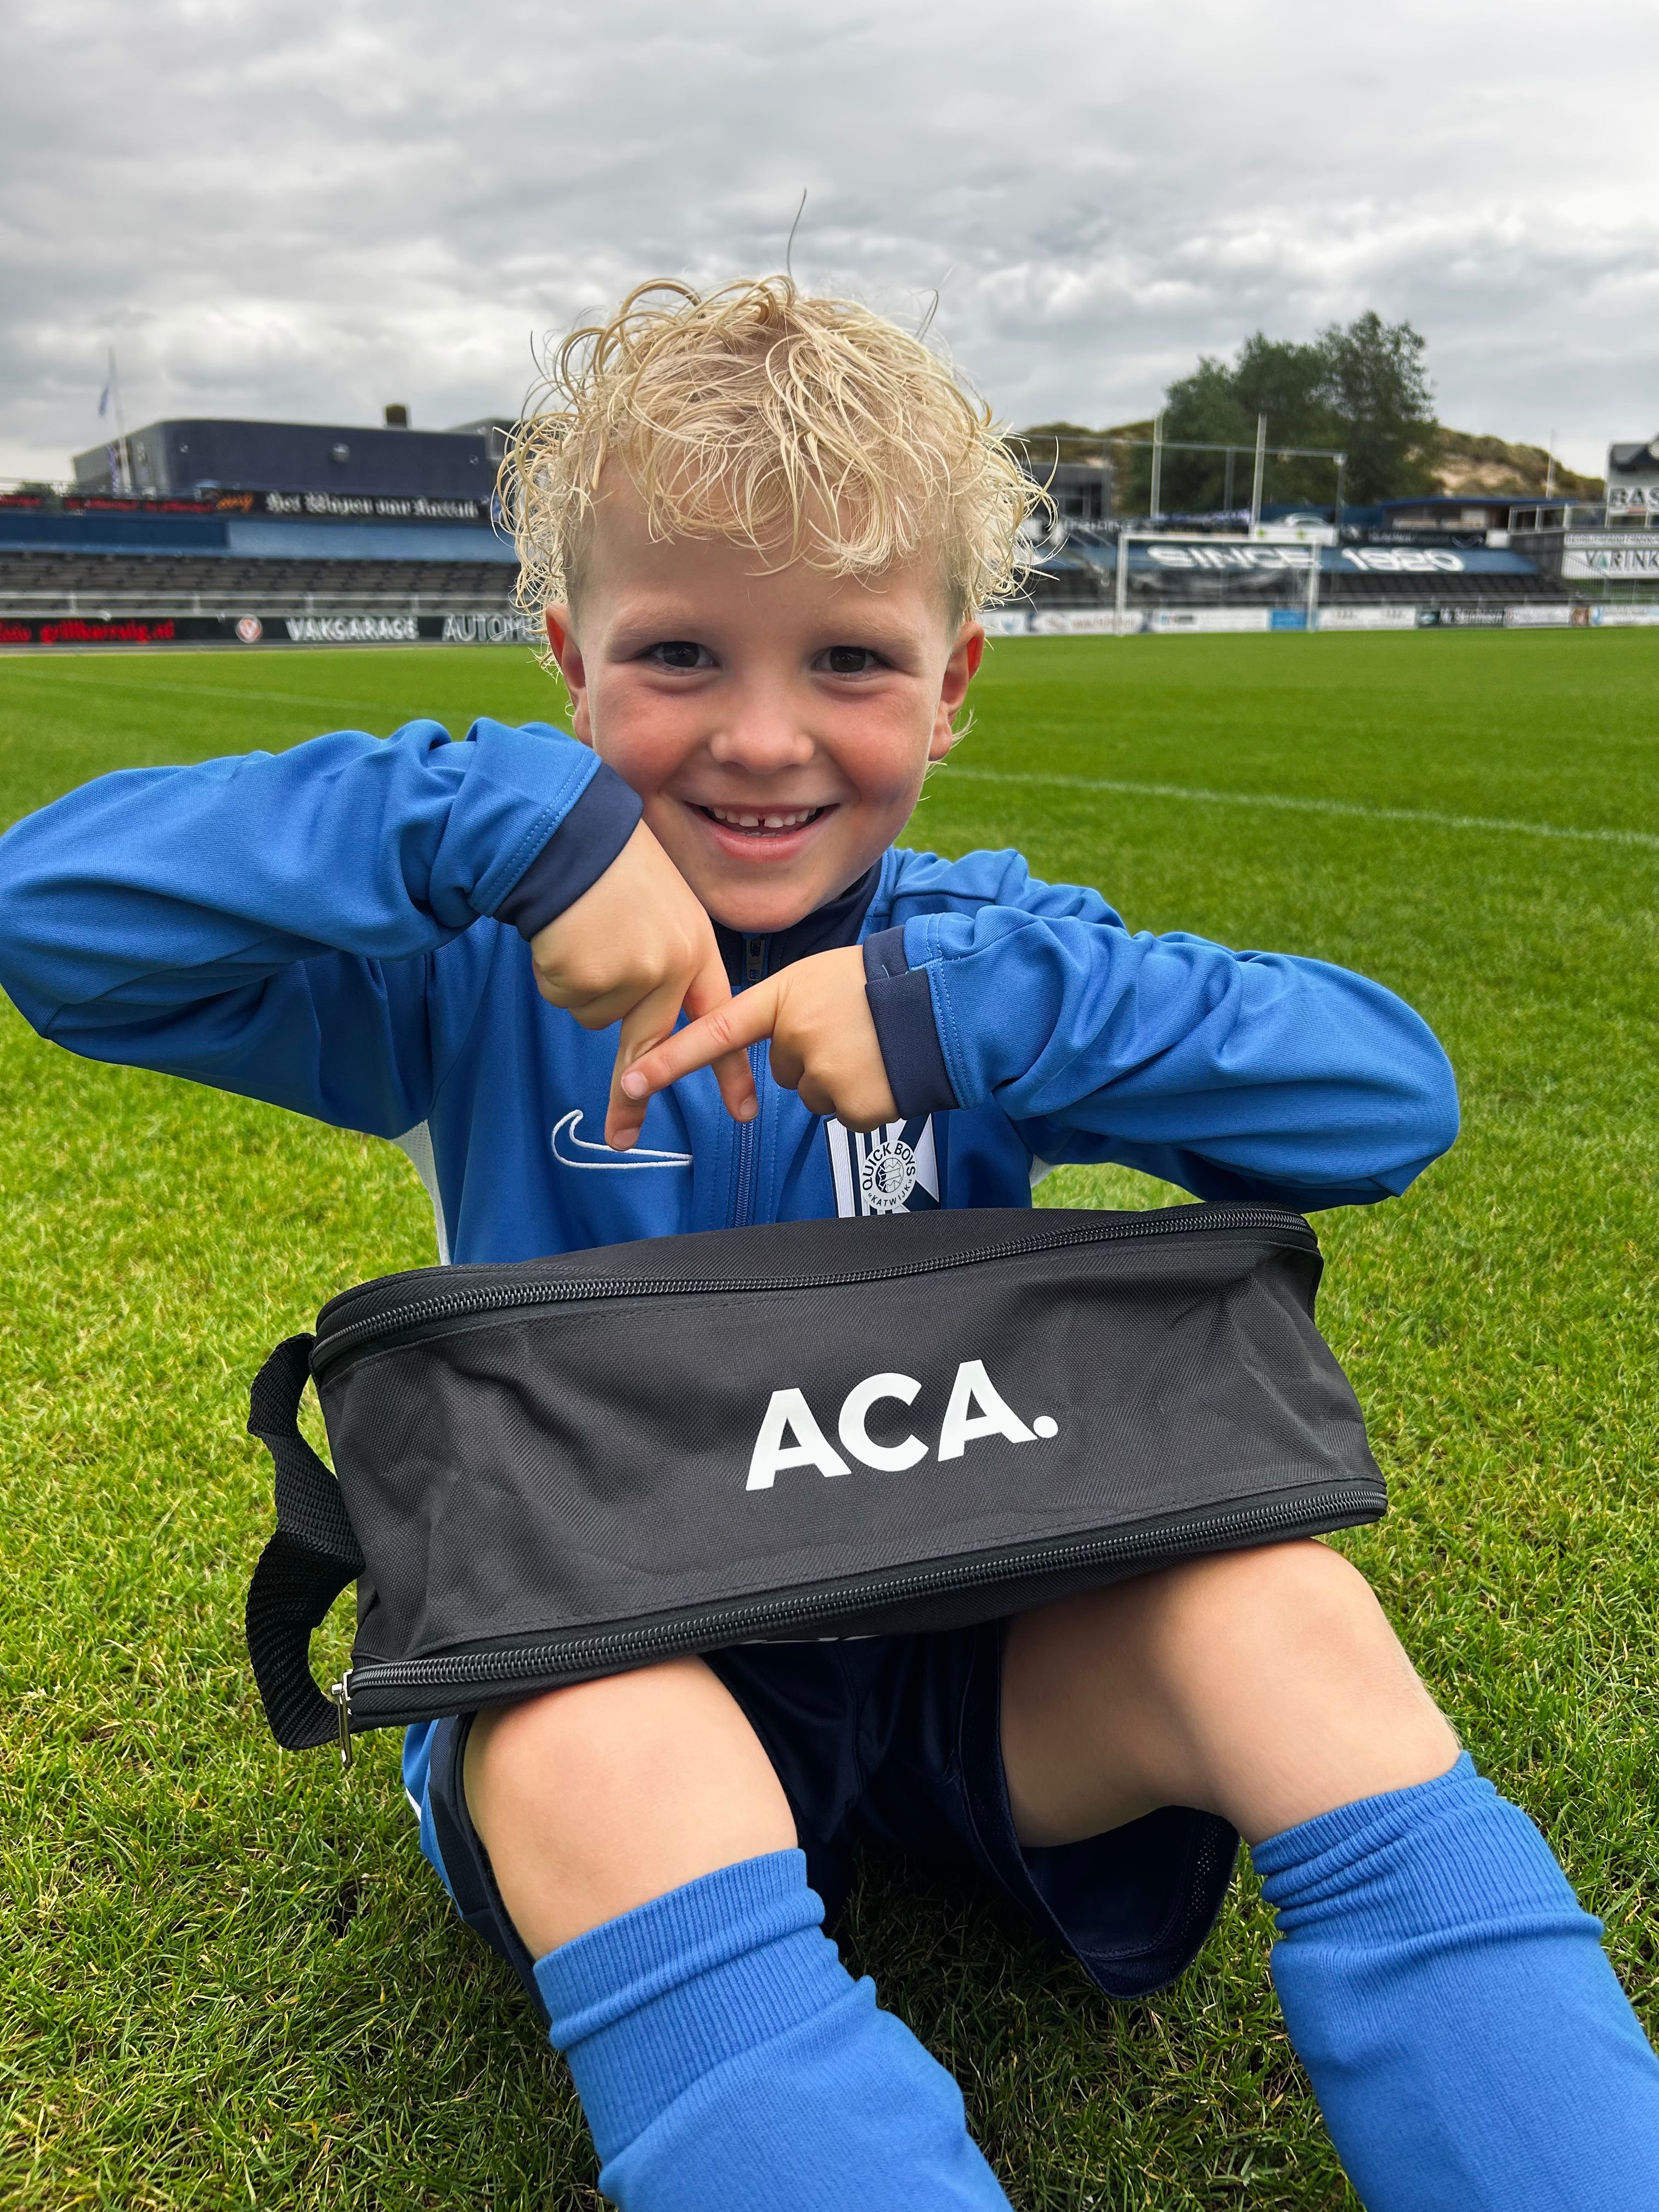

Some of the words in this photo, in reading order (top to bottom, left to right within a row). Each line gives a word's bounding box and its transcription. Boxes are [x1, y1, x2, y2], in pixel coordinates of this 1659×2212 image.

[1147, 547, 1323, 569] SINCE
[284, 617, 419, 641] VAKGARAGE
[862, 1142, 892, 1191] QUICK
[894, 1142, 916, 1177] BOYS
[745, 1359, 1059, 1491] ACA.
